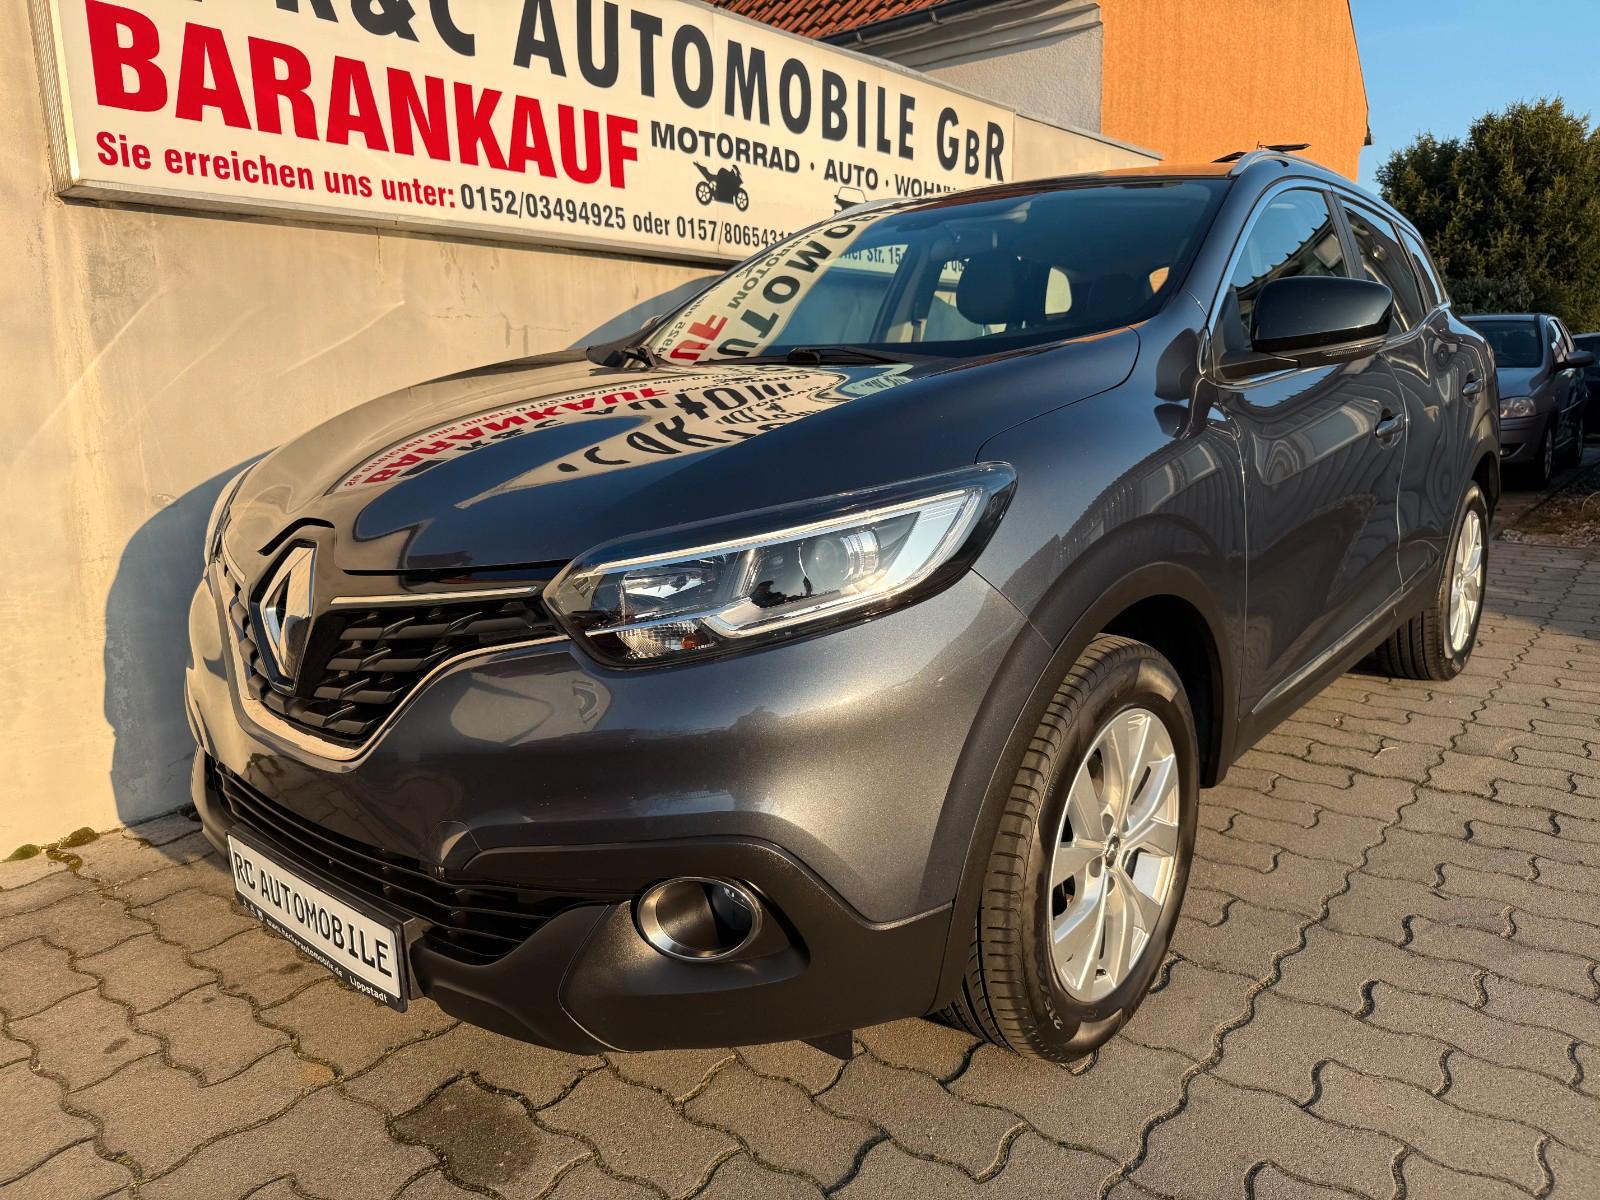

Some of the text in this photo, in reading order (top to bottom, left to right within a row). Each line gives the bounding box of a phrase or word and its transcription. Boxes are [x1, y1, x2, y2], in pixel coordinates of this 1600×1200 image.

[85, 0, 638, 189] BARANKAUF
[513, 0, 915, 159] AUTOMOBILE
[96, 131, 793, 248] Sie erreichen uns unter: 0152/03494925 oder 0157/8065431
[650, 120, 800, 173] MOTORRAD
[824, 158, 878, 190] AUTO
[233, 851, 393, 978] RC AUTOMOBILE
[350, 975, 388, 1003] Lippstadt
